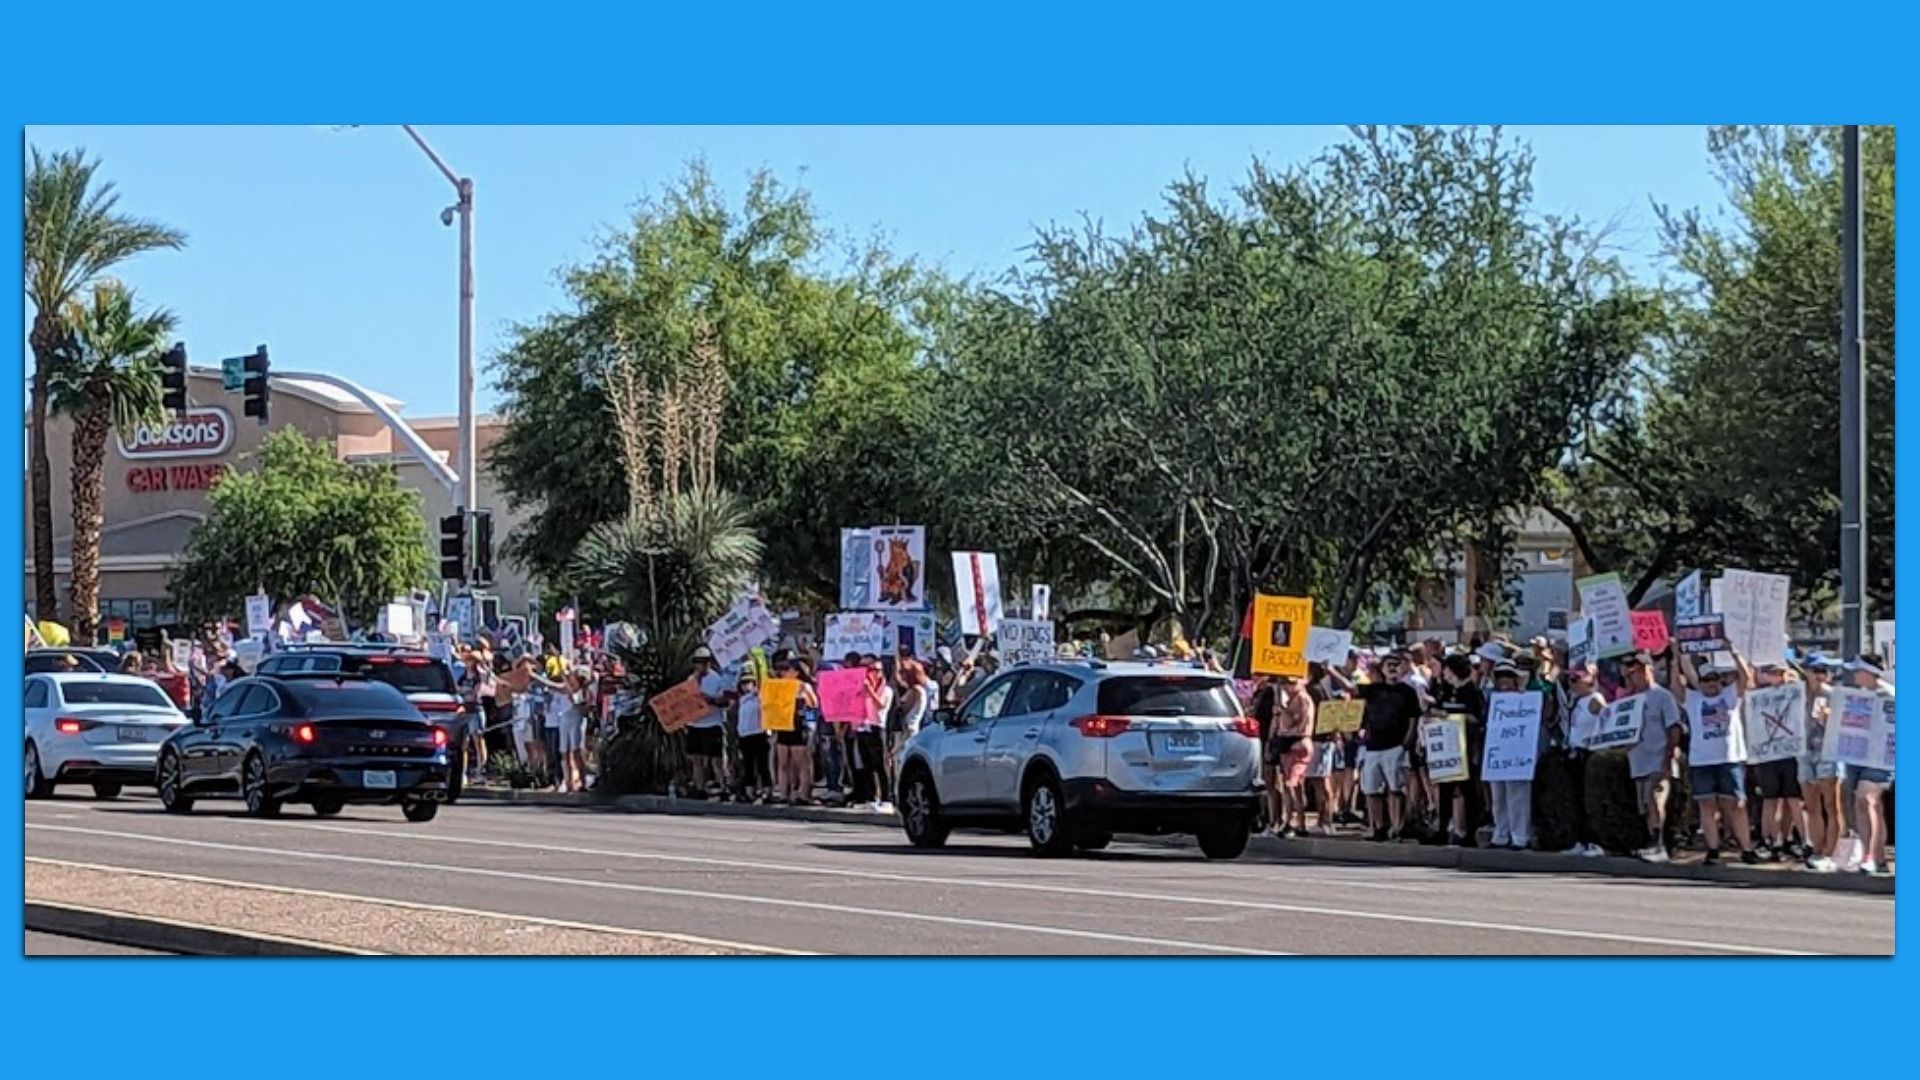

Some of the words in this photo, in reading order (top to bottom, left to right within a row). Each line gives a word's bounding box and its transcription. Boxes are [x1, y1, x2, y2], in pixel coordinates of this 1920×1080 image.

[127, 468, 167, 492] CAR
[1265, 602, 1307, 622] RESIST
[1501, 725, 1526, 738] NOT
